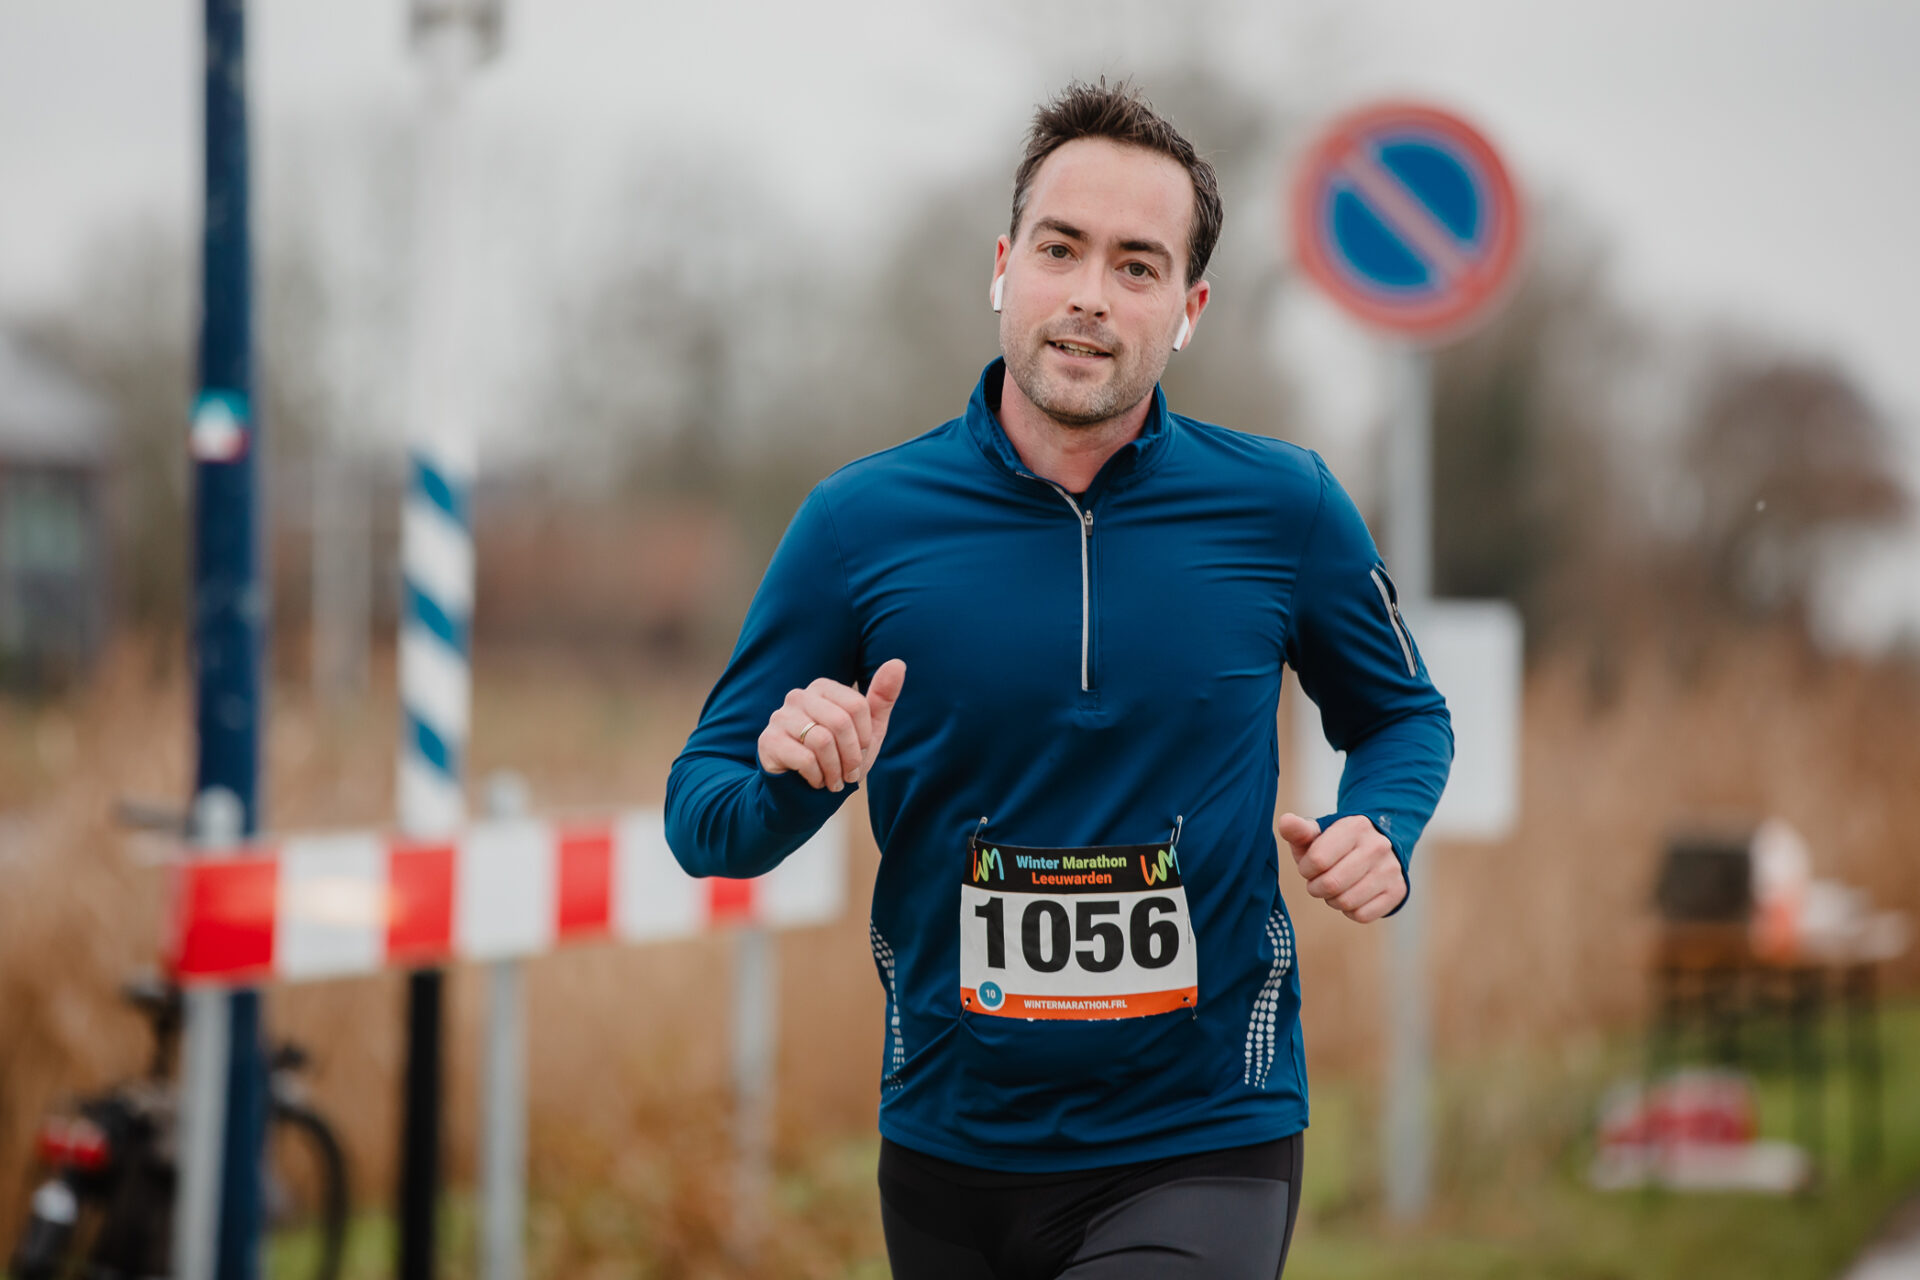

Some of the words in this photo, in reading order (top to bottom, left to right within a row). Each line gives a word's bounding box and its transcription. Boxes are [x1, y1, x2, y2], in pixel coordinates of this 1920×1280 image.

[1016, 854, 1060, 869] Winter
[1062, 854, 1127, 869] Marathon
[1031, 871, 1112, 885] Leeuwarden
[975, 896, 1179, 973] 1056
[985, 988, 997, 999] 10
[1023, 999, 1127, 1010] WINTERMARATHON.FRL
